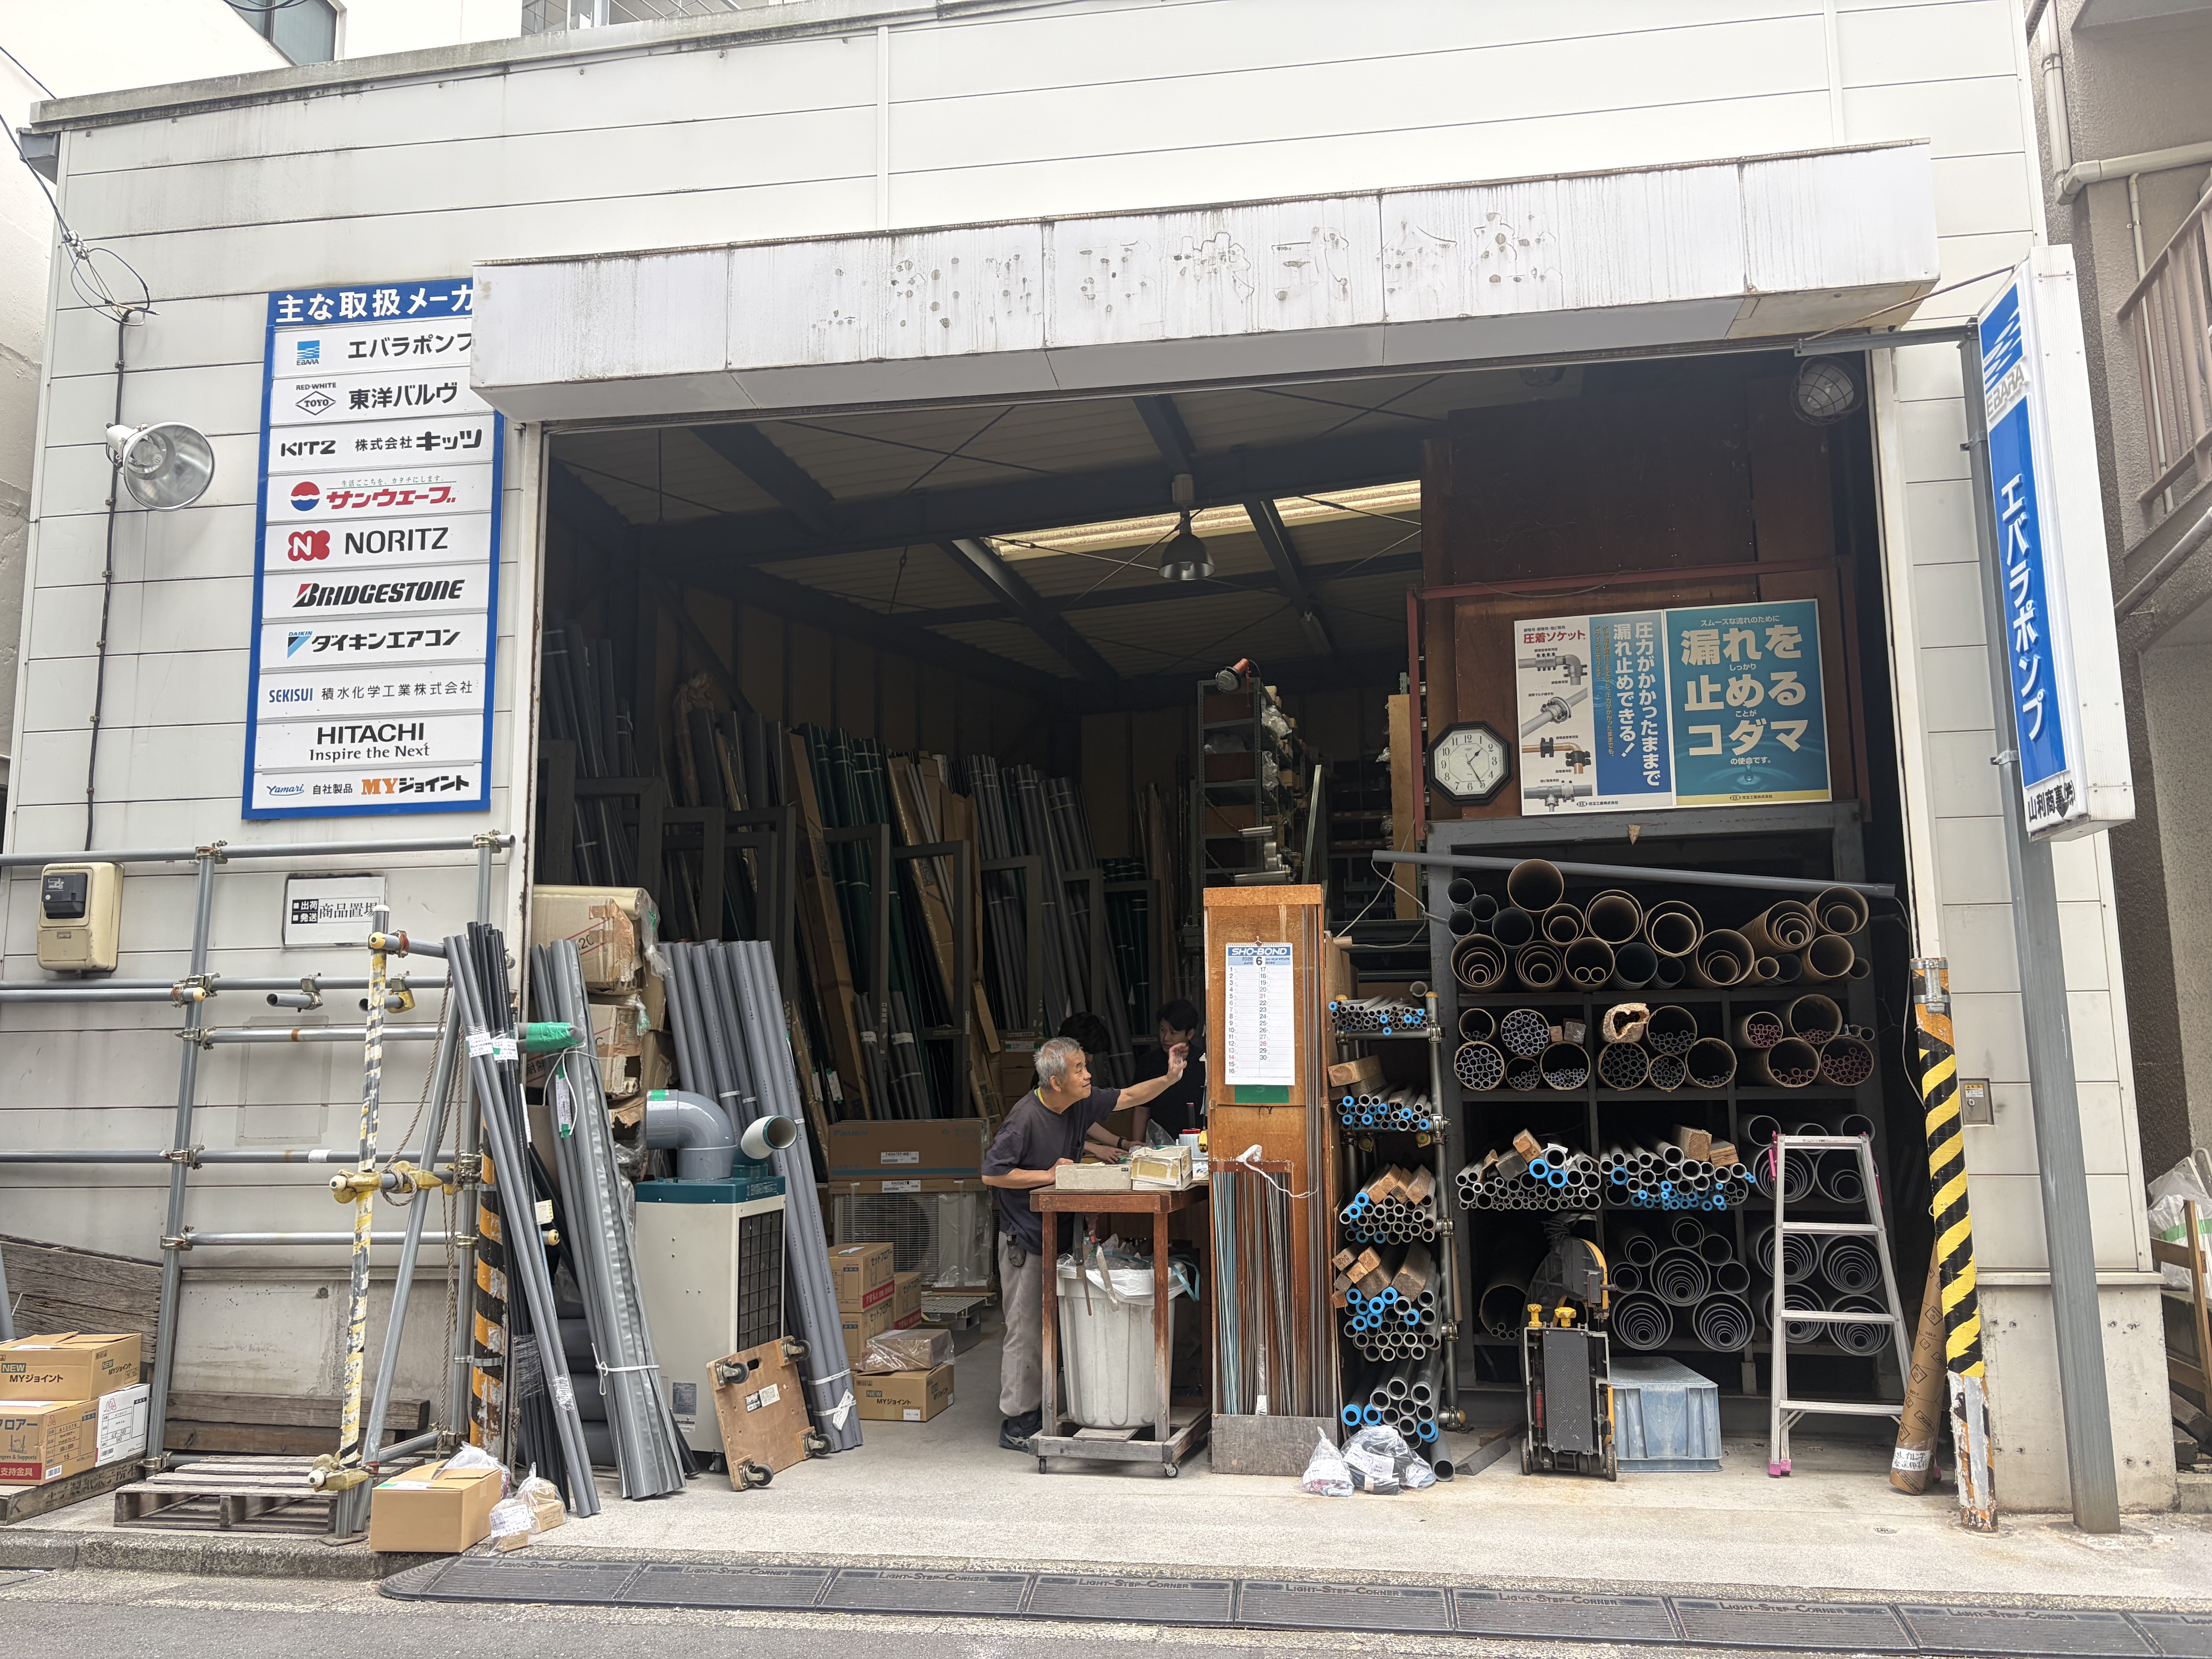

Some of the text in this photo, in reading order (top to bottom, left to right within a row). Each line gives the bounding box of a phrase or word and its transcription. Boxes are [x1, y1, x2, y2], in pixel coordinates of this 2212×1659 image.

[1987, 363, 2025, 416] EBARA
[349, 382, 457, 410] 東洋バルヴ
[304, 399, 329, 407] TOYO
[355, 429, 482, 452] 株式会社キッツ
[281, 440, 336, 457] KITZ
[345, 527, 448, 554] NORITZ
[292, 580, 465, 608] BRIDGESTONE
[2001, 473, 2046, 742] エバラポンプ
[1701, 615, 1780, 627] スムーズな流れのために
[312, 629, 460, 652] ダイキンエアコン
[1523, 630, 1585, 644] 圧着ソケット
[1681, 624, 1803, 665] 漏れを
[1729, 663, 1756, 671] しっかり
[269, 688, 313, 702] SEKISUI
[322, 680, 472, 700] 積水化学工業株式会社
[1685, 671, 1806, 711] 止める
[1635, 622, 1661, 786] 圧力がかかったままで
[317, 723, 424, 744] HITACHI
[1465, 734, 1472, 743] 12
[1688, 718, 1808, 756] コダマ
[1452, 737, 1458, 745] 11
[309, 743, 429, 763] Inspire the Next
[1443, 747, 1450, 756] 10
[1488, 744, 1494, 752] 2
[1441, 760, 1446, 769] 9
[1730, 756, 1771, 765] の使命です。
[1444, 772, 1450, 781] 8
[1488, 770, 1493, 778] 4
[266, 783, 304, 796] Yamari
[313, 783, 353, 794] 自社製品
[362, 775, 469, 795] MYジョイント
[1454, 781, 1460, 790] 7
[1467, 782, 1473, 791] 6
[1480, 780, 1486, 788] 5
[301, 901, 318, 910] 出荷
[319, 902, 377, 919] 商品置場
[300, 913, 317, 922] 発送
[1256, 957, 1262, 965] 6
[102, 1360, 113, 1369] NEW
[108, 1362, 132, 1375] MYジョイント
[10, 1374, 64, 1382] MYジョイント
[0, 1467, 33, 1476] 支持金具
